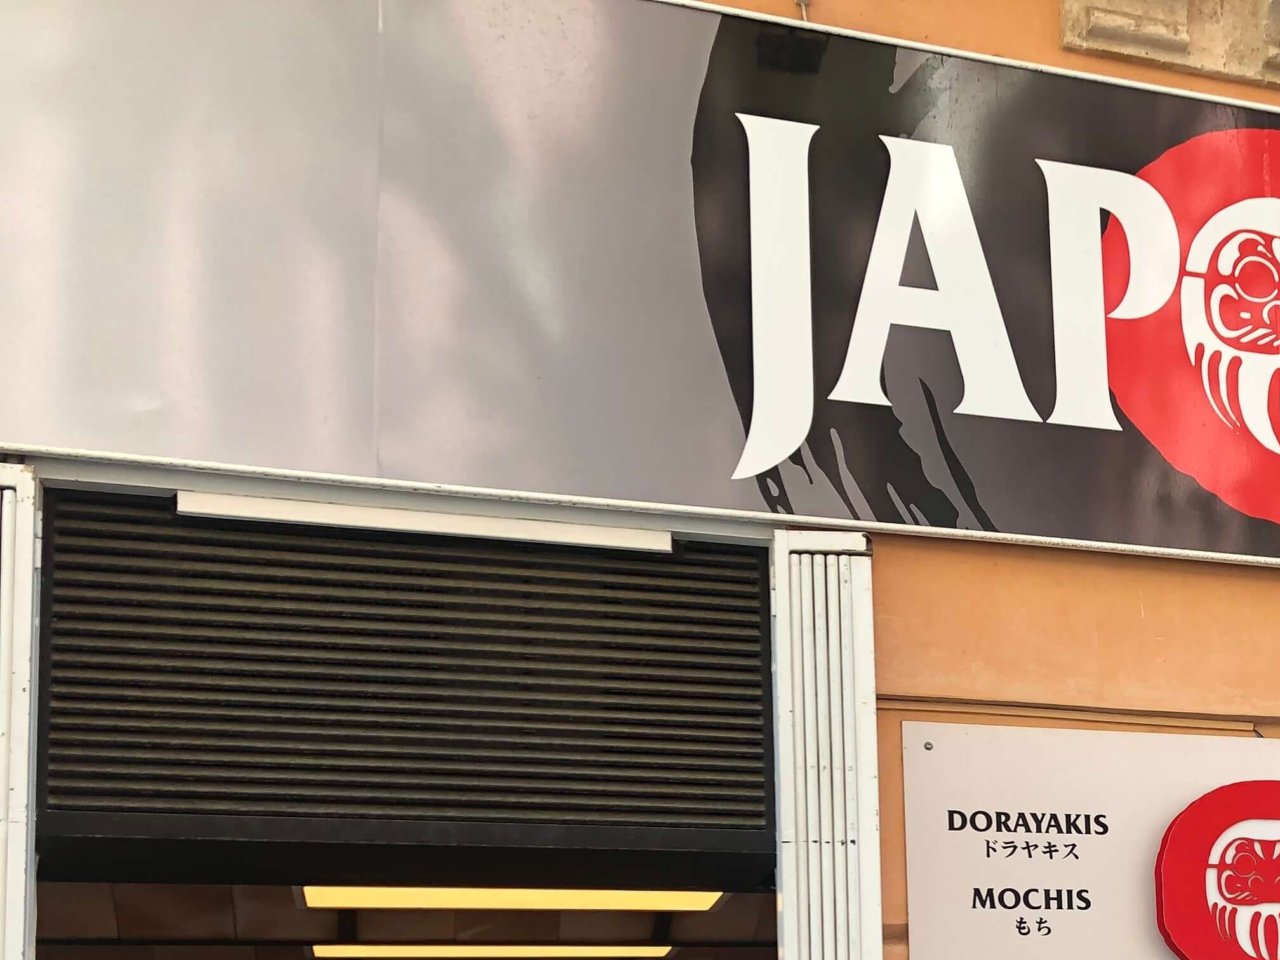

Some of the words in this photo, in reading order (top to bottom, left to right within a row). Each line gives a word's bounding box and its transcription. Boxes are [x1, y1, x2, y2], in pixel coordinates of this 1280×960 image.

[948, 810, 1108, 835] DORAYAKIS
[985, 840, 1079, 859] ドラヤキス
[972, 888, 1091, 910] MOCHIS
[1016, 917, 1051, 936] もち
